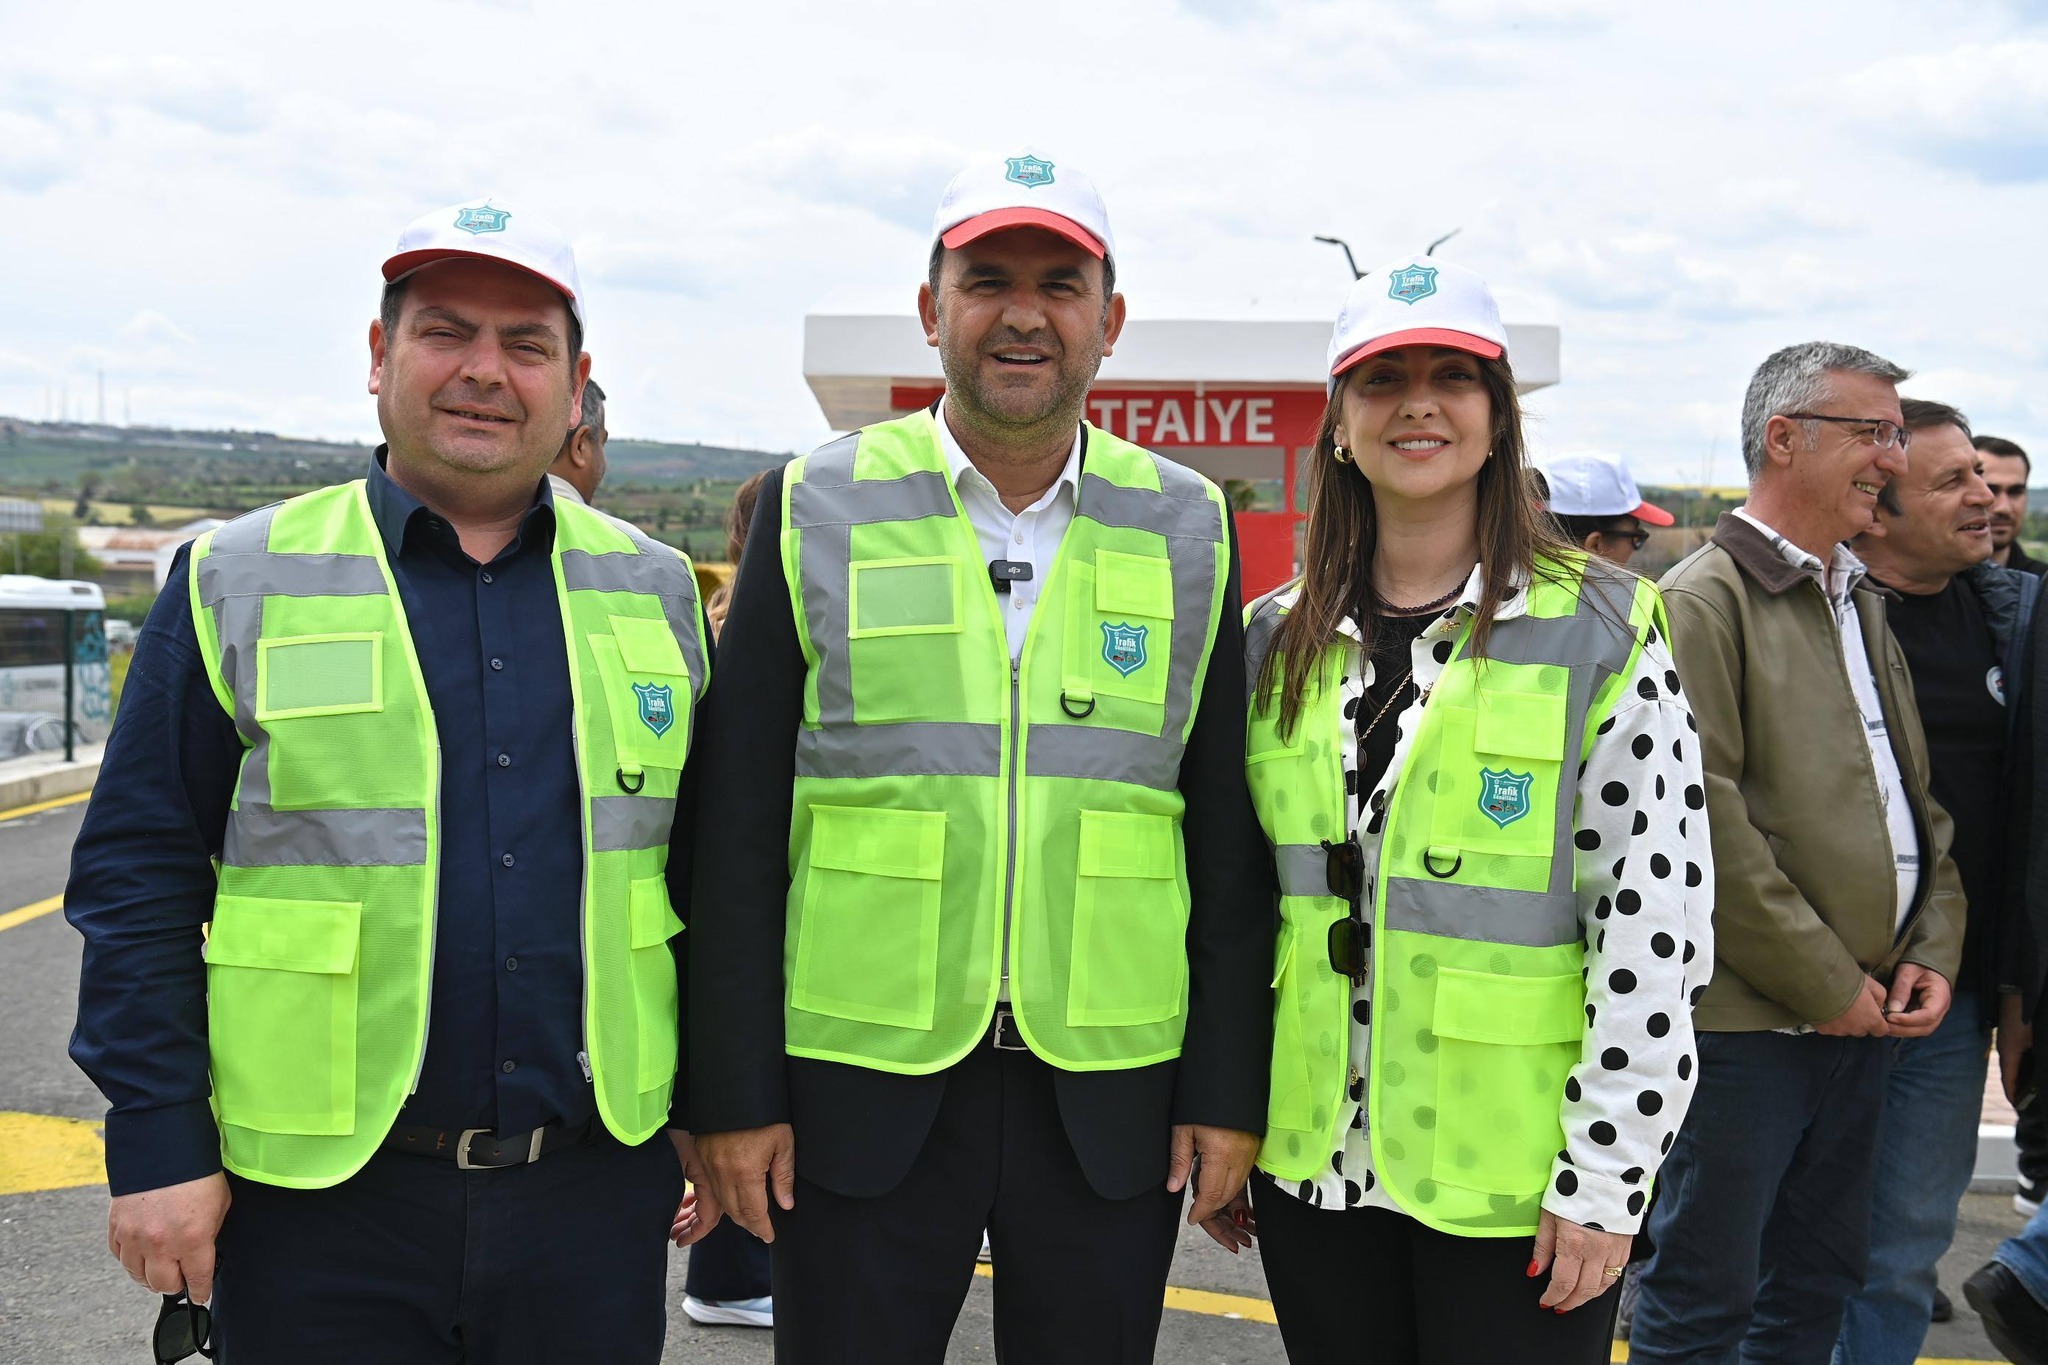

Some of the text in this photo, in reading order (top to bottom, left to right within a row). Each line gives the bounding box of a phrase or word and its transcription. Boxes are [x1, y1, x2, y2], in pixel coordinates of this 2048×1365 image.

[1081, 388, 1275, 442] TFAİYE
[1114, 637, 1136, 647] Trafik
[1494, 785, 1518, 796] Trafik
